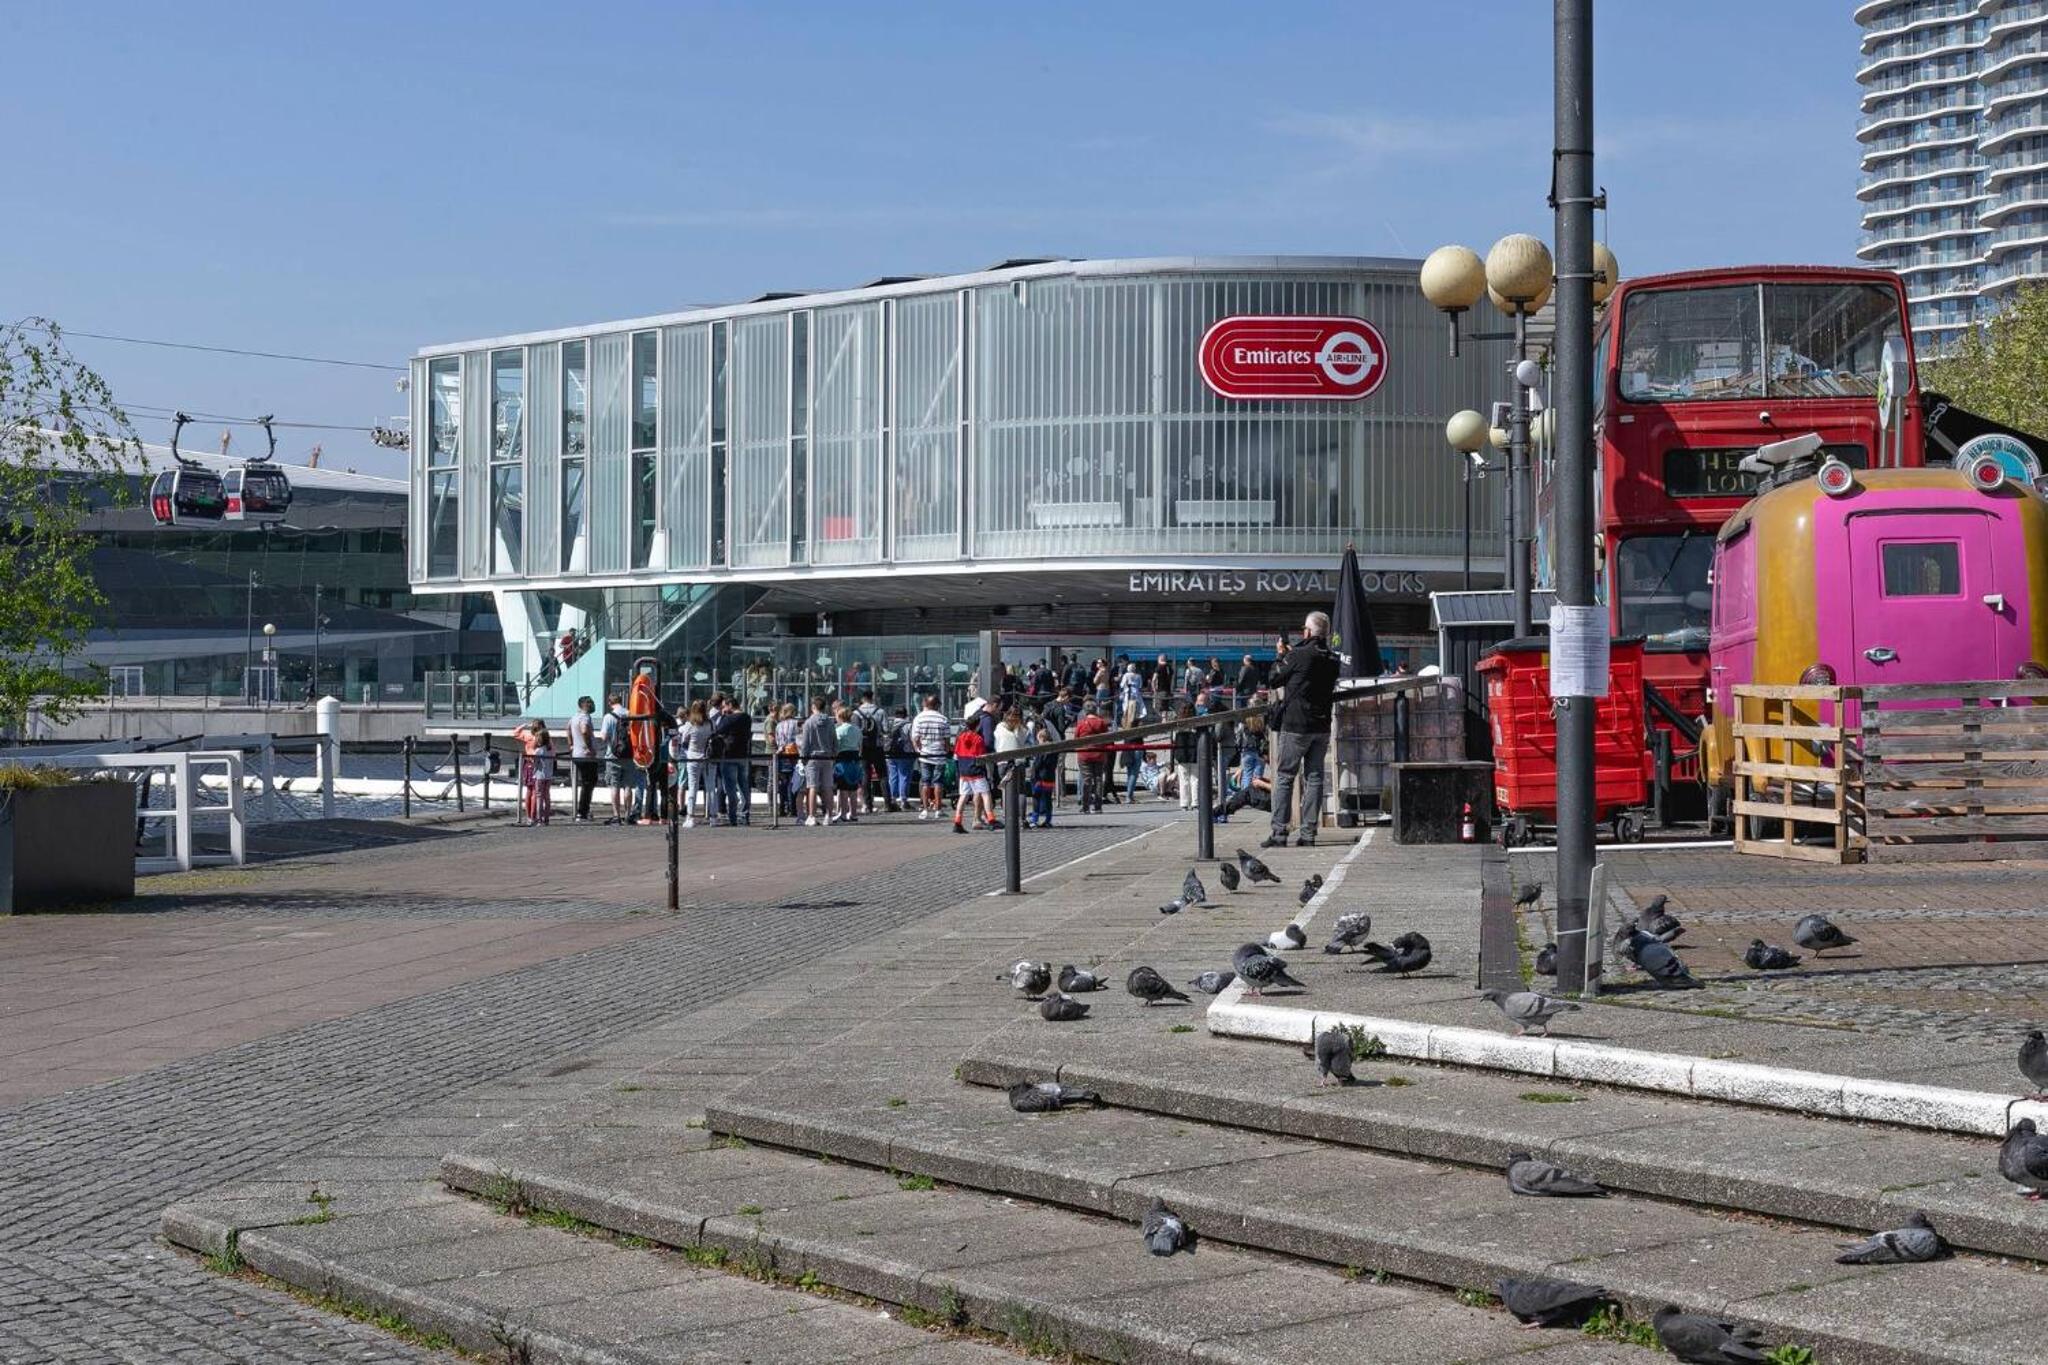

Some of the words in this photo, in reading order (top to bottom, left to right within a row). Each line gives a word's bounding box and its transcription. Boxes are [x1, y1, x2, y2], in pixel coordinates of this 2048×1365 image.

[1233, 347, 1311, 365] Emirates
[1129, 573, 1246, 592] EMIRATES
[1256, 573, 1337, 592] ROYAL
[1360, 573, 1426, 593] OCKS
